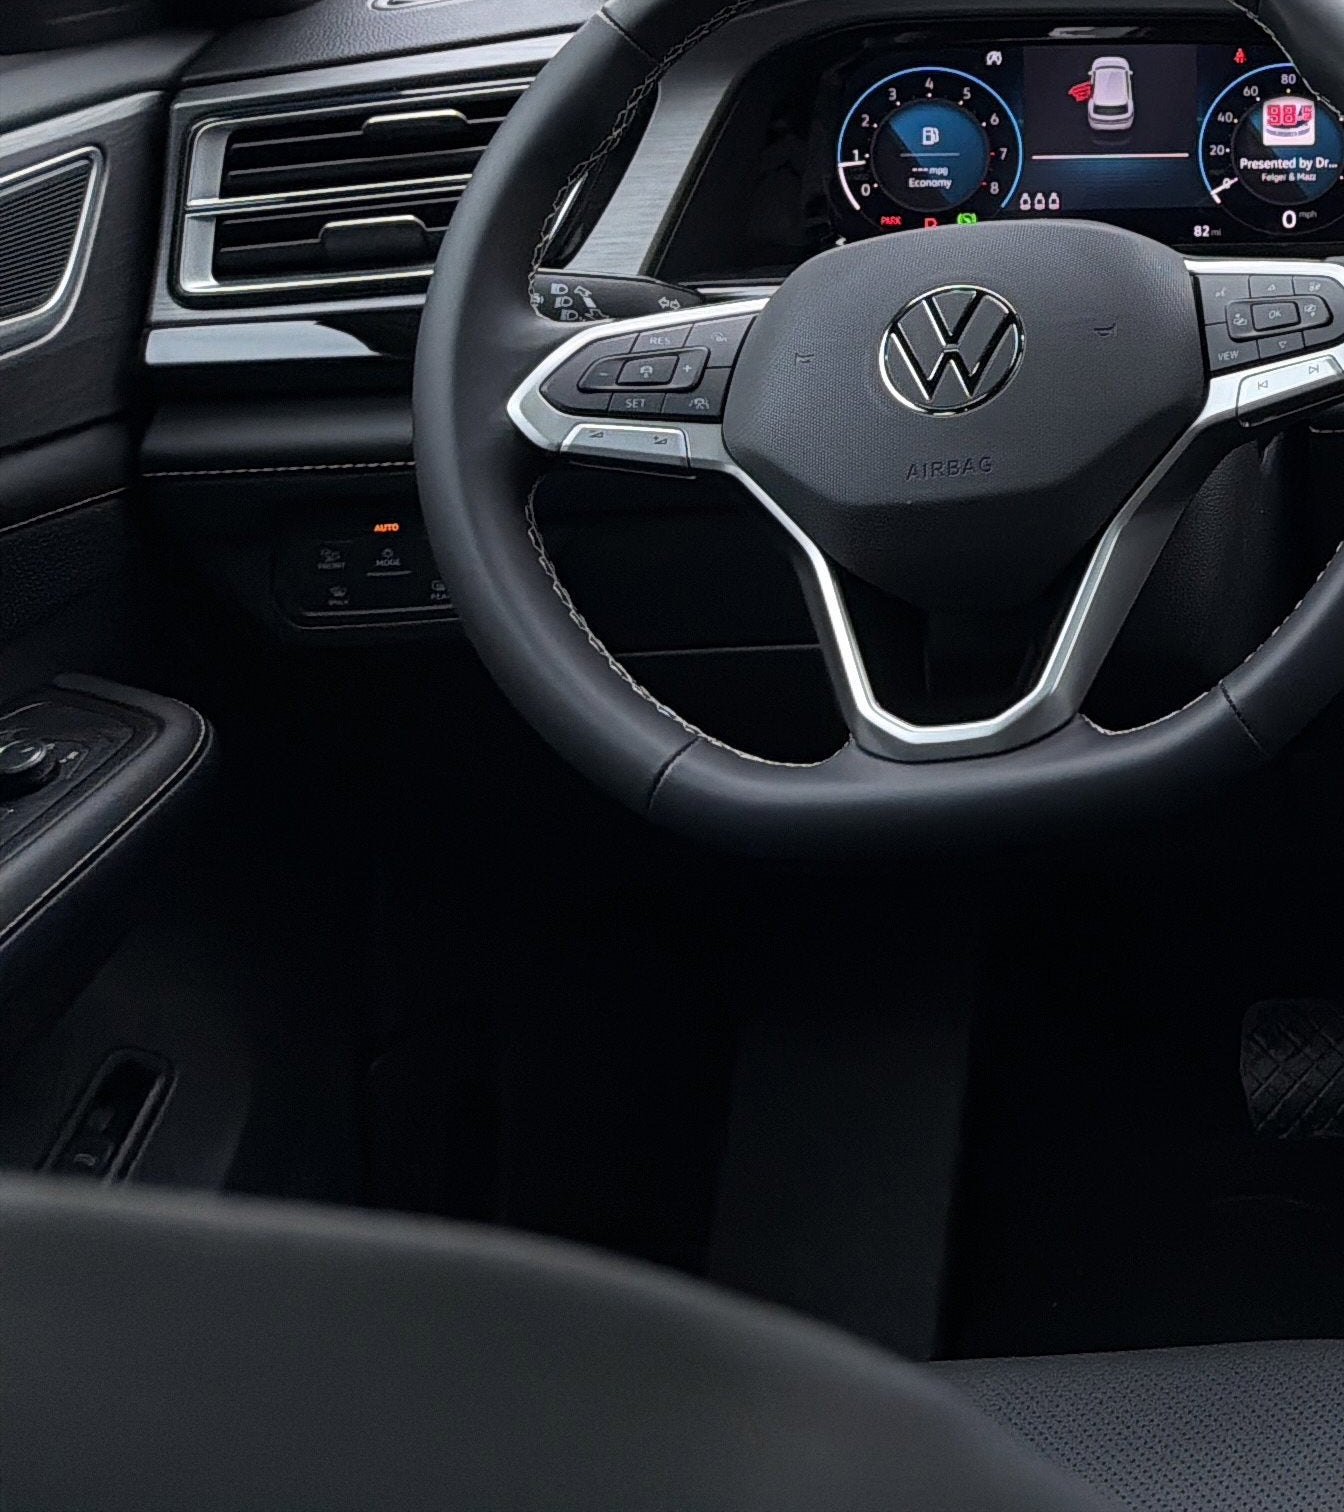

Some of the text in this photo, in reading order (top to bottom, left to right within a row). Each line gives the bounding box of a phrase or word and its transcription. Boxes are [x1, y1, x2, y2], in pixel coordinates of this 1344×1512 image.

[924, 77, 934, 90] 4
[1280, 73, 1297, 85] 80
[888, 87, 897, 101] 3
[963, 86, 972, 100] 5
[1243, 85, 1259, 97] 60
[861, 114, 870, 127] 2
[990, 113, 1000, 126] 6
[1217, 112, 1233, 123] 40
[852, 149, 859, 161] 1
[999, 147, 1008, 160] 7
[1209, 144, 1225, 156] 20
[1239, 157, 1297, 169] Presented
[1299, 157, 1312, 172] by
[908, 177, 952, 189] Economy
[990, 181, 1000, 195] 8
[861, 183, 871, 197] 0
[1281, 210, 1297, 229] 0
[1193, 225, 1210, 238] 82
[1268, 309, 1282, 319] OK
[649, 336, 671, 346] RES
[1218, 350, 1239, 361] VIEW
[625, 398, 646, 409] SET
[906, 456, 993, 481] AIRBAG
[373, 522, 400, 533] AUTO
